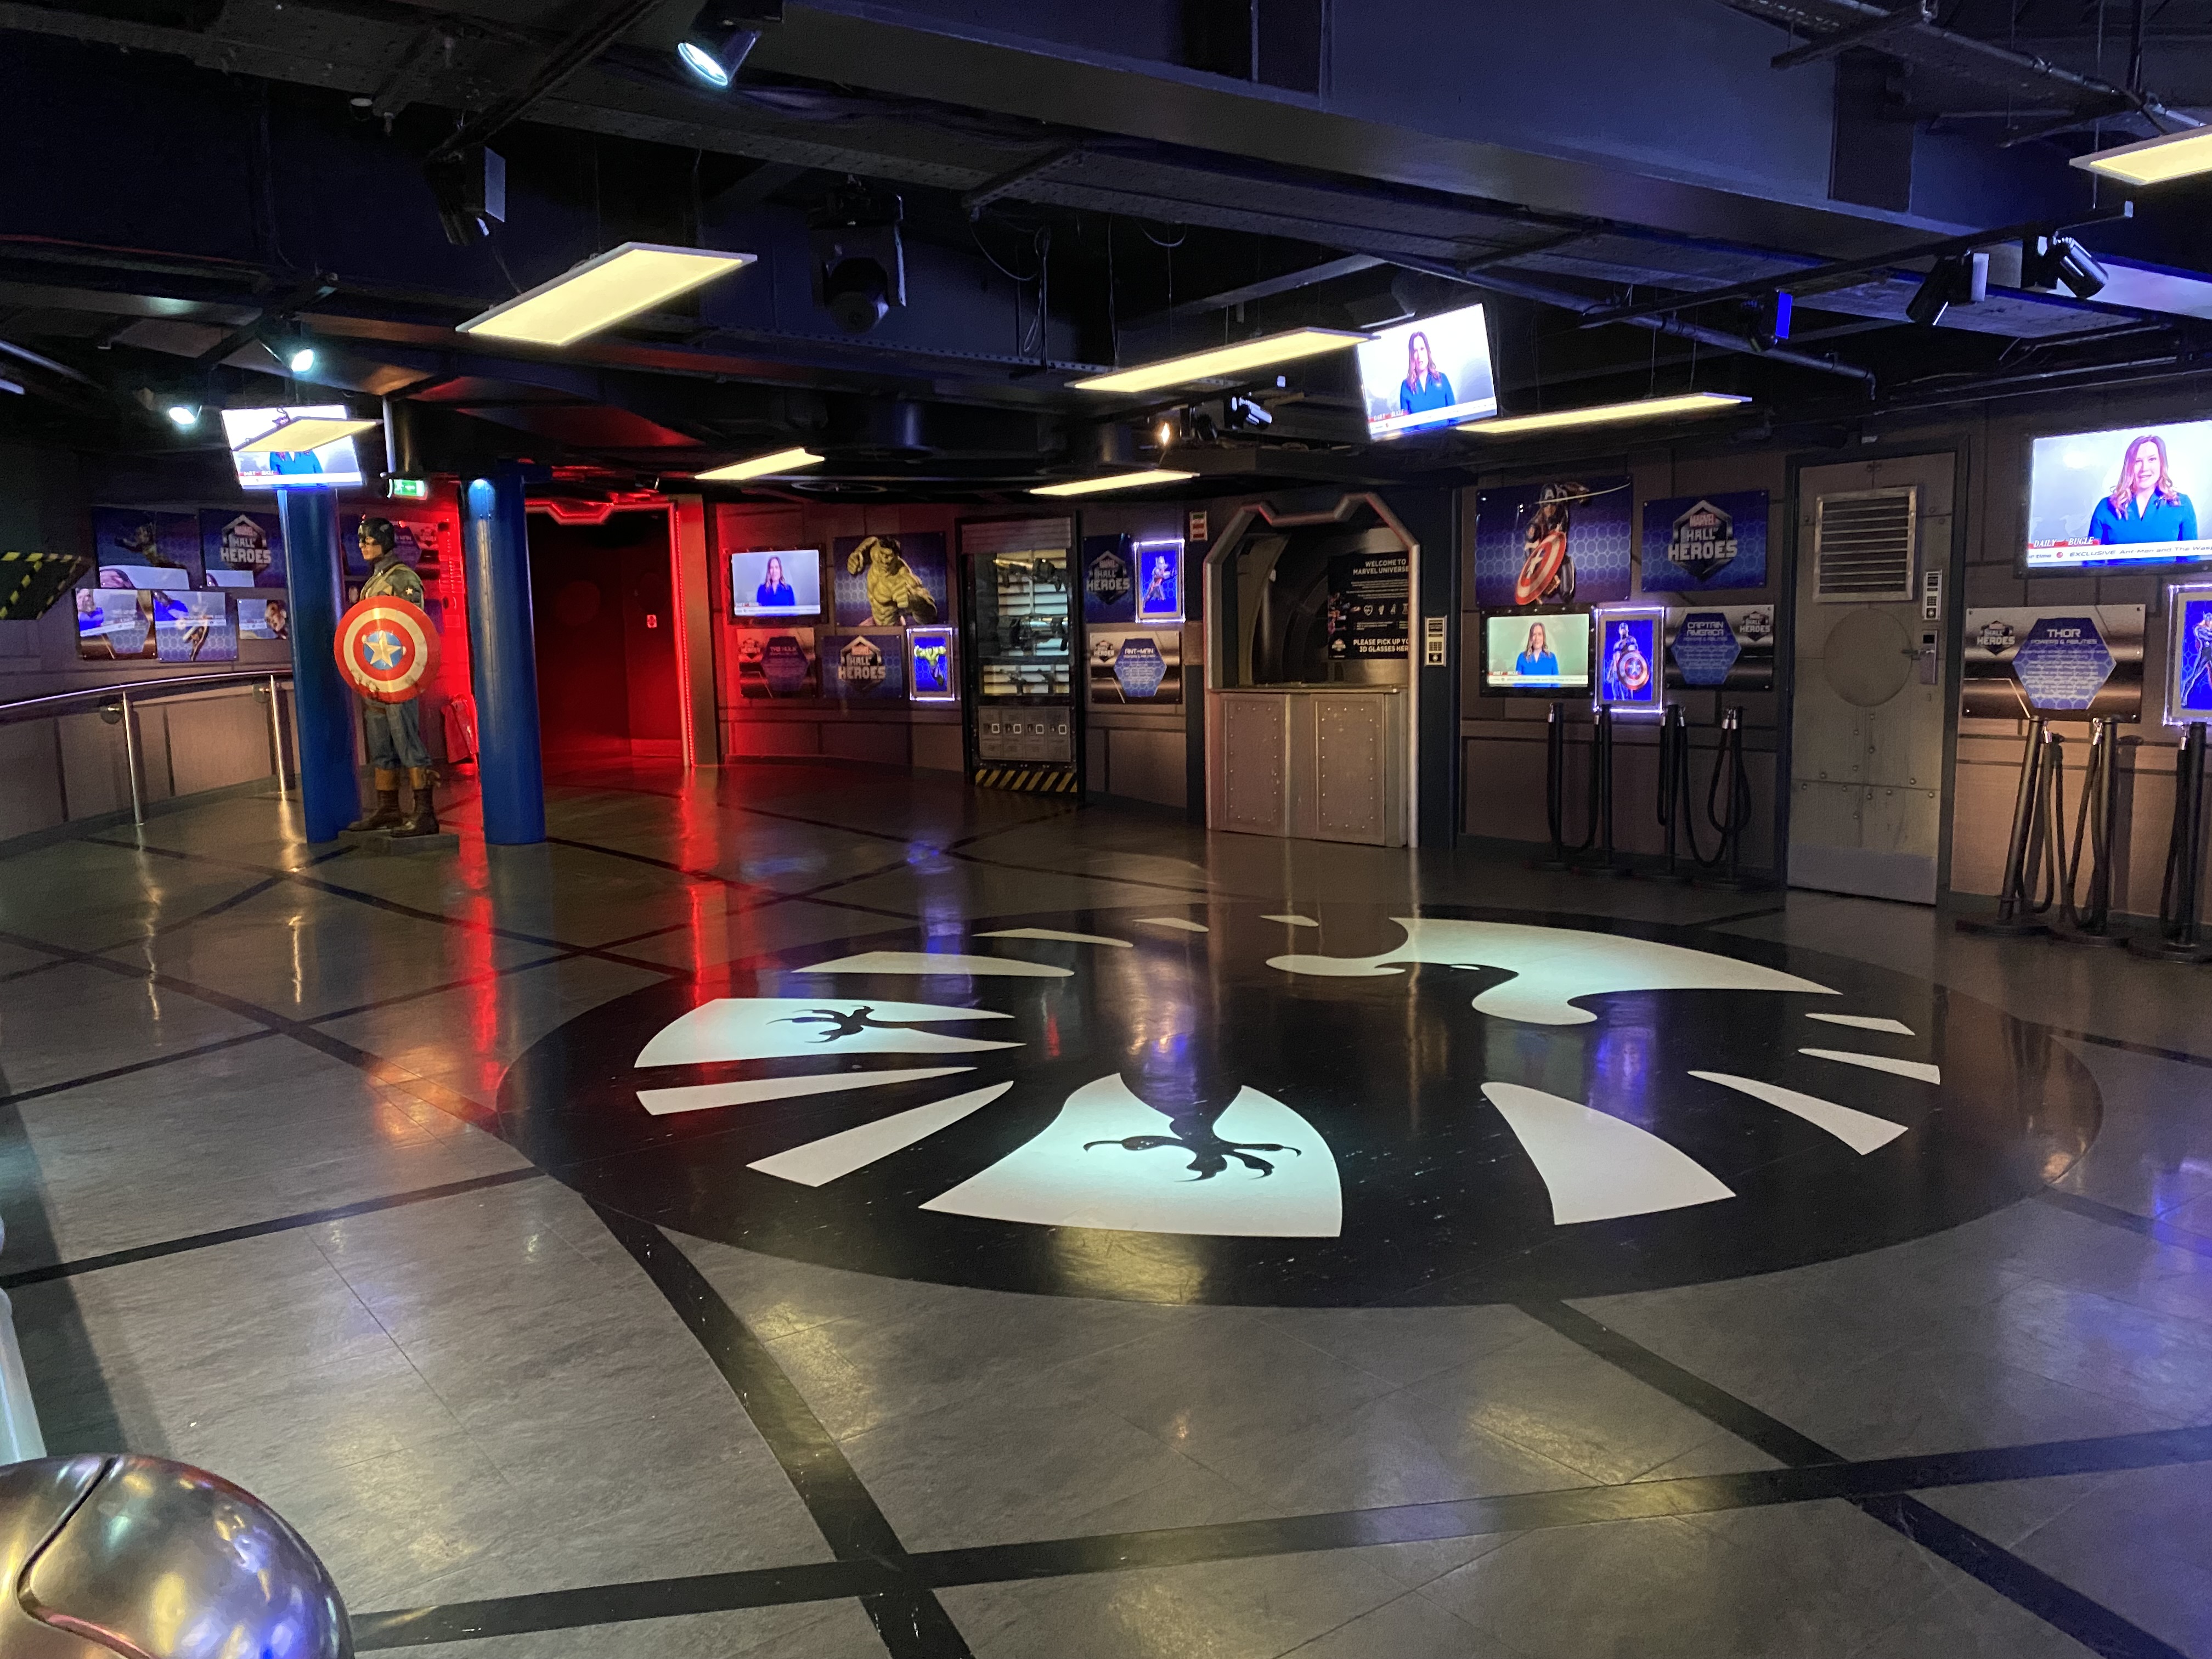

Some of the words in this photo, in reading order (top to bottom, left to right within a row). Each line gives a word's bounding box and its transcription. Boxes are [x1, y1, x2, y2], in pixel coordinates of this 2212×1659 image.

[1690, 514, 1714, 527] MARVEL
[1686, 527, 1716, 541] HALL
[234, 538, 255, 548] HALL
[2033, 539, 2057, 548] DAILY
[2068, 537, 2095, 546] BUGLE
[221, 547, 272, 563] HEROES
[1668, 539, 1738, 561] HEROES
[1365, 559, 1396, 567] WELCOME
[1098, 569, 1116, 578] HALL
[1086, 578, 1130, 591] HEROES
[2046, 629, 2081, 638] THOR
[1977, 636, 2016, 645] HEROES
[850, 656, 871, 665] HALL
[838, 665, 885, 680] HEROES
